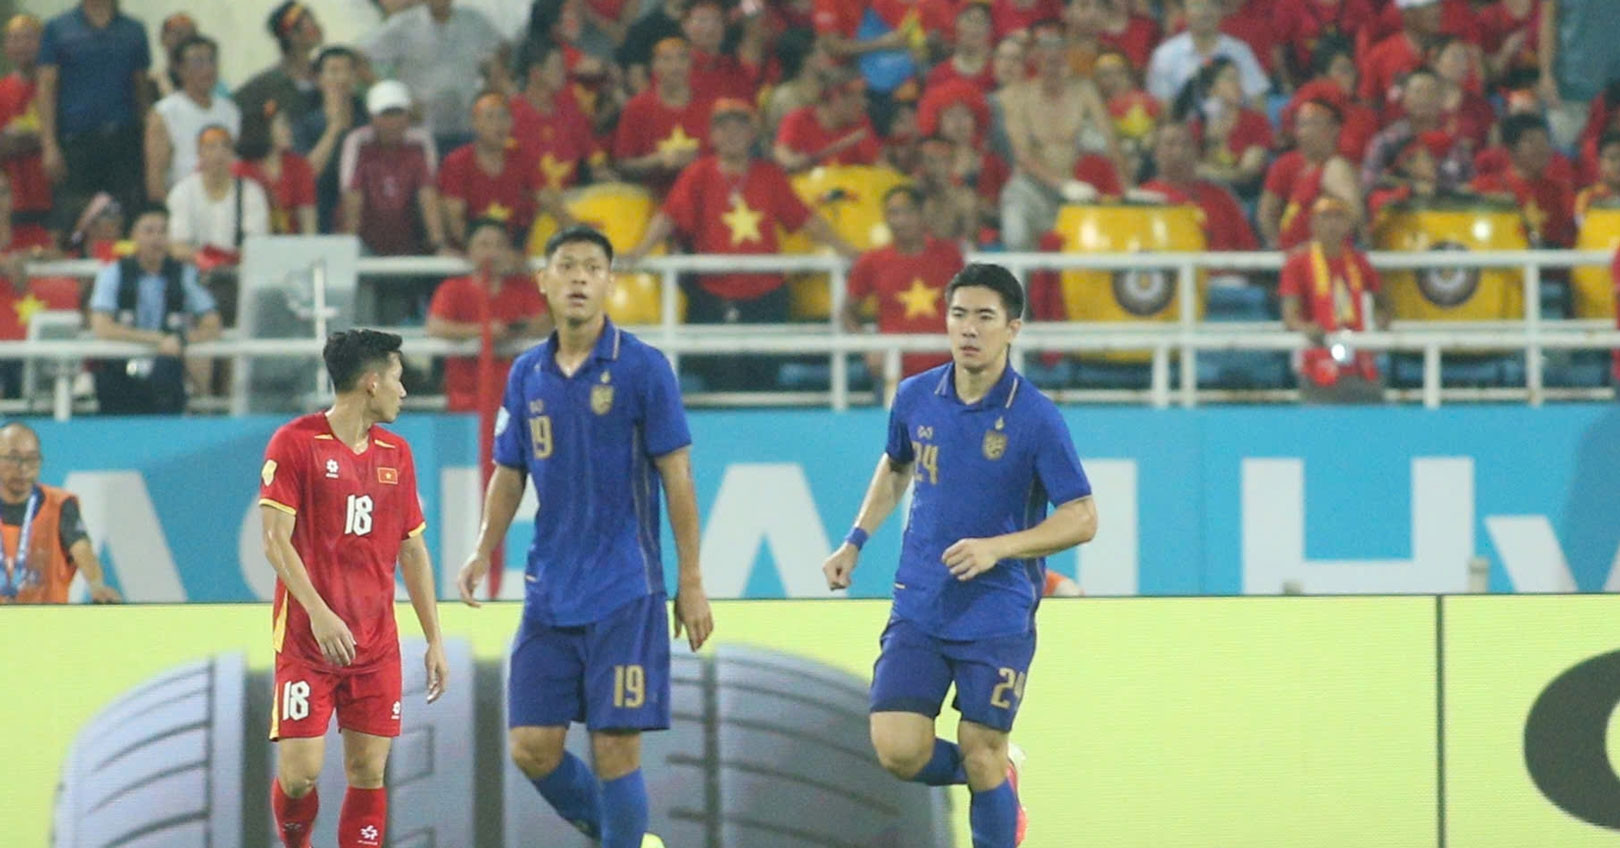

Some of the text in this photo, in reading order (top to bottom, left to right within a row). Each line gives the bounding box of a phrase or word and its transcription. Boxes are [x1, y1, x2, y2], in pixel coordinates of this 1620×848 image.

[528, 415, 554, 459] 19
[344, 494, 374, 536] 18
[282, 680, 311, 721] 18
[613, 664, 646, 709] 19
